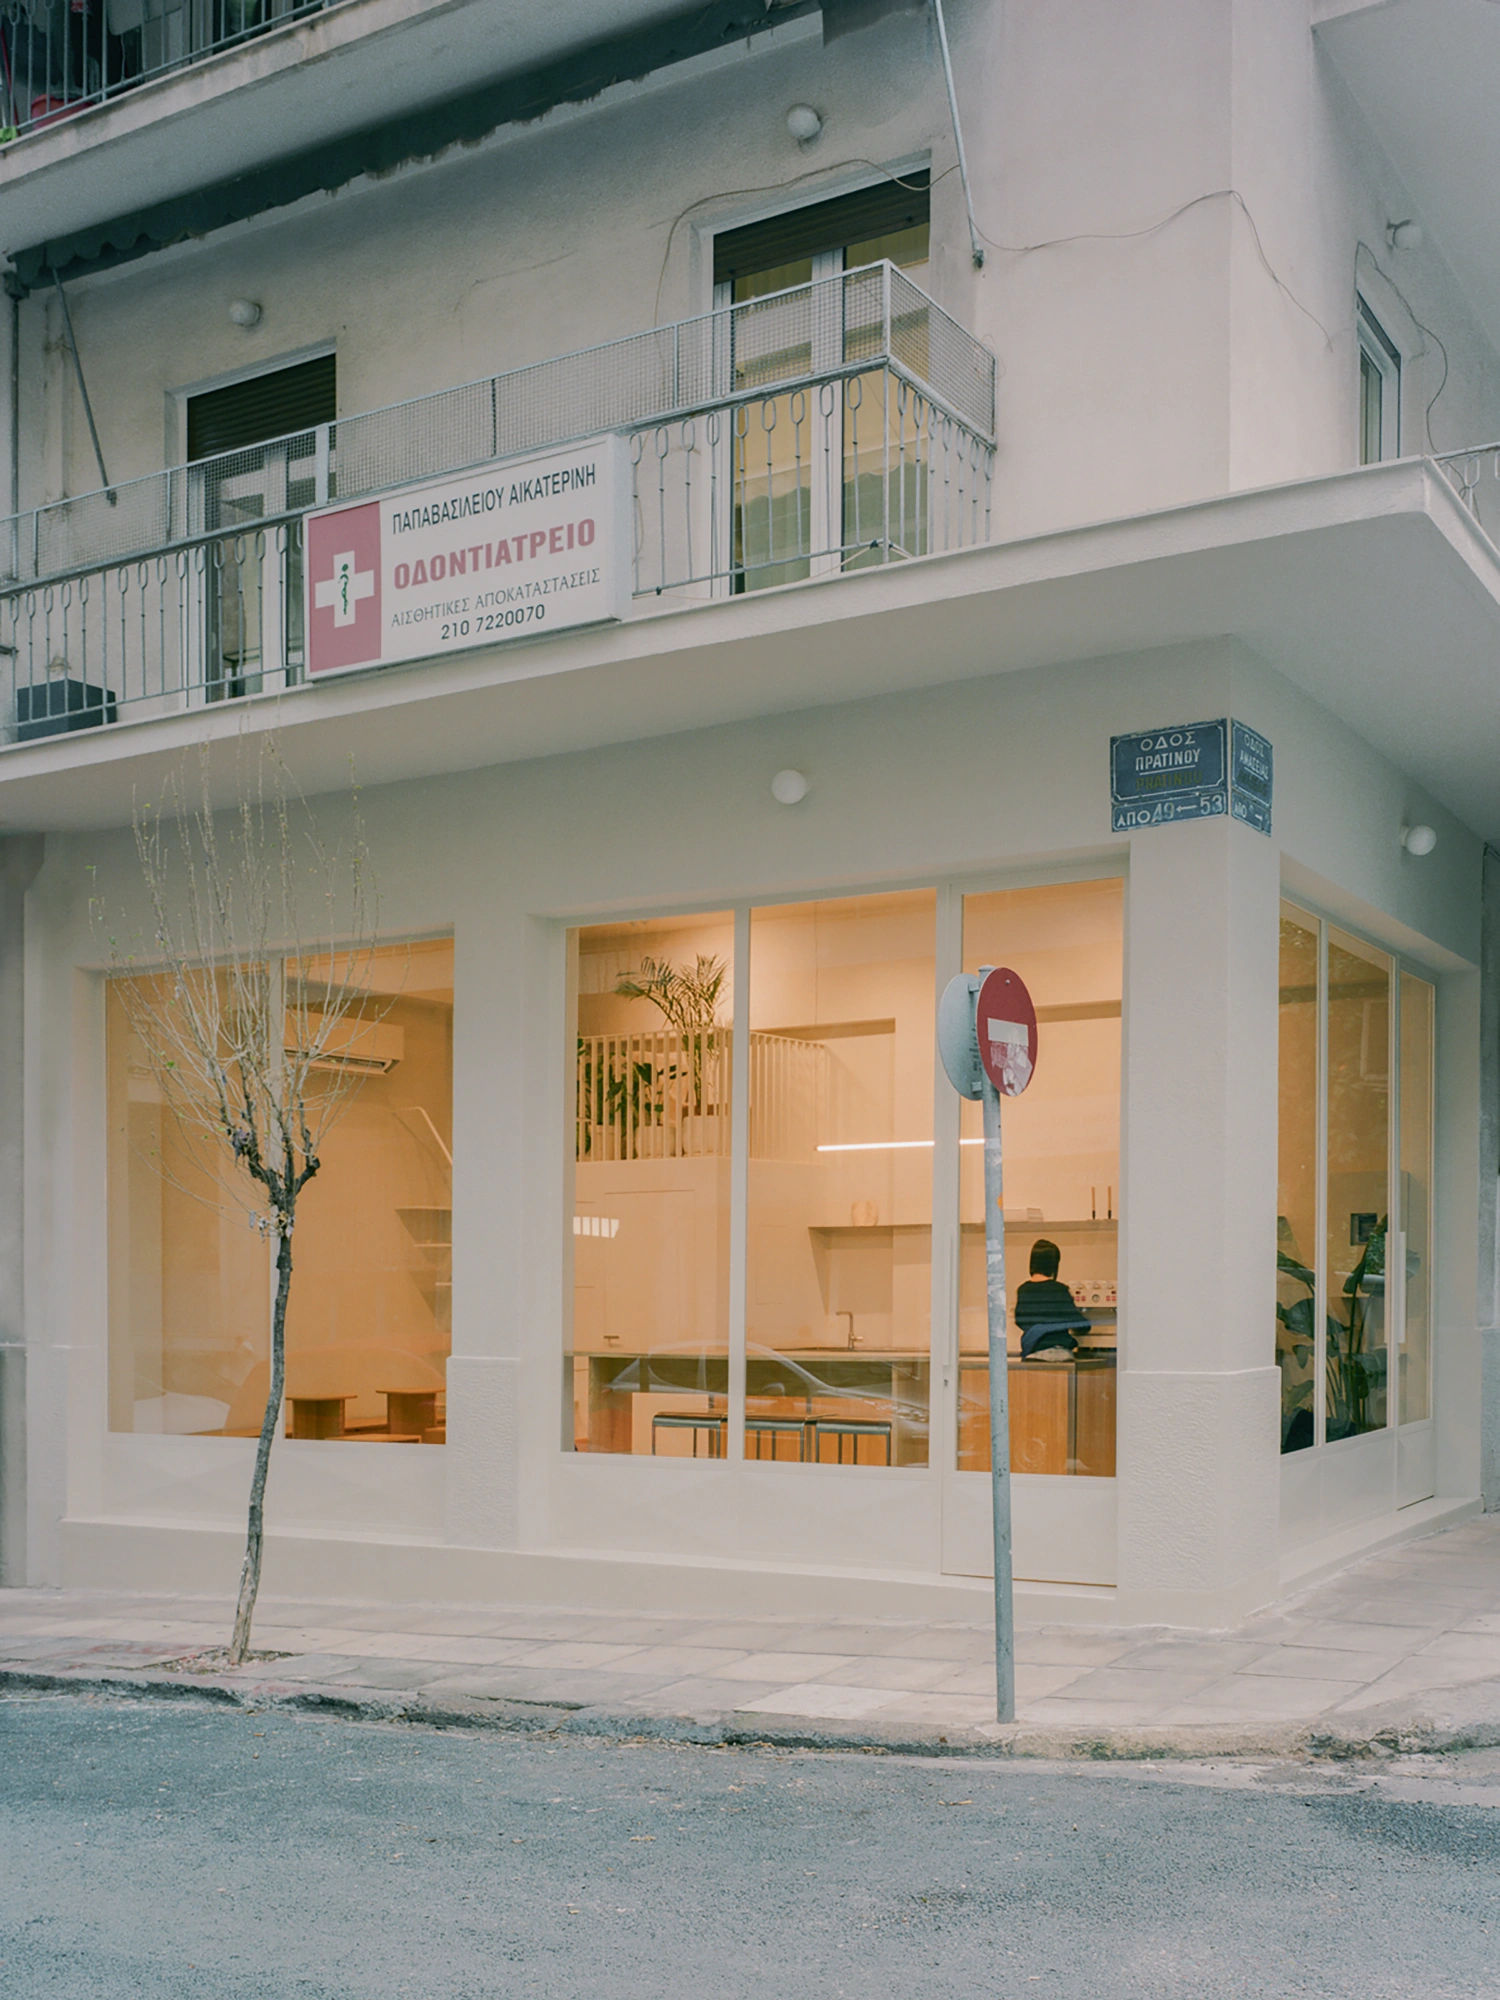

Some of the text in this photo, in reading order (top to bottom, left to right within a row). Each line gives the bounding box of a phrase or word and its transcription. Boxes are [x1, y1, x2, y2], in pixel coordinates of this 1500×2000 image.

[393, 463, 596, 534] ΠΑΠΑΒΑΣΙΛΕΙΟΥ ΑΙΚΑΤΕΡΙΝΗ
[394, 518, 595, 590] ΟΔΟΝΤΙΑΤΡΕΙΟ
[391, 568, 600, 628] ΑΙΣΘΗΤΙΚΕΣ ΑΠΟΚΑΤΑΣΤΑΣΕΙΣ
[441, 604, 545, 640] 210 7220070
[1140, 731, 1196, 751] ΟΔΟΣ
[1135, 748, 1201, 772] ΠΡΑΤΙΝΟΥ
[1136, 770, 1203, 792] PRATINOU
[1117, 809, 1151, 828] ΑΠΟ
[1200, 794, 1223, 815] 53
